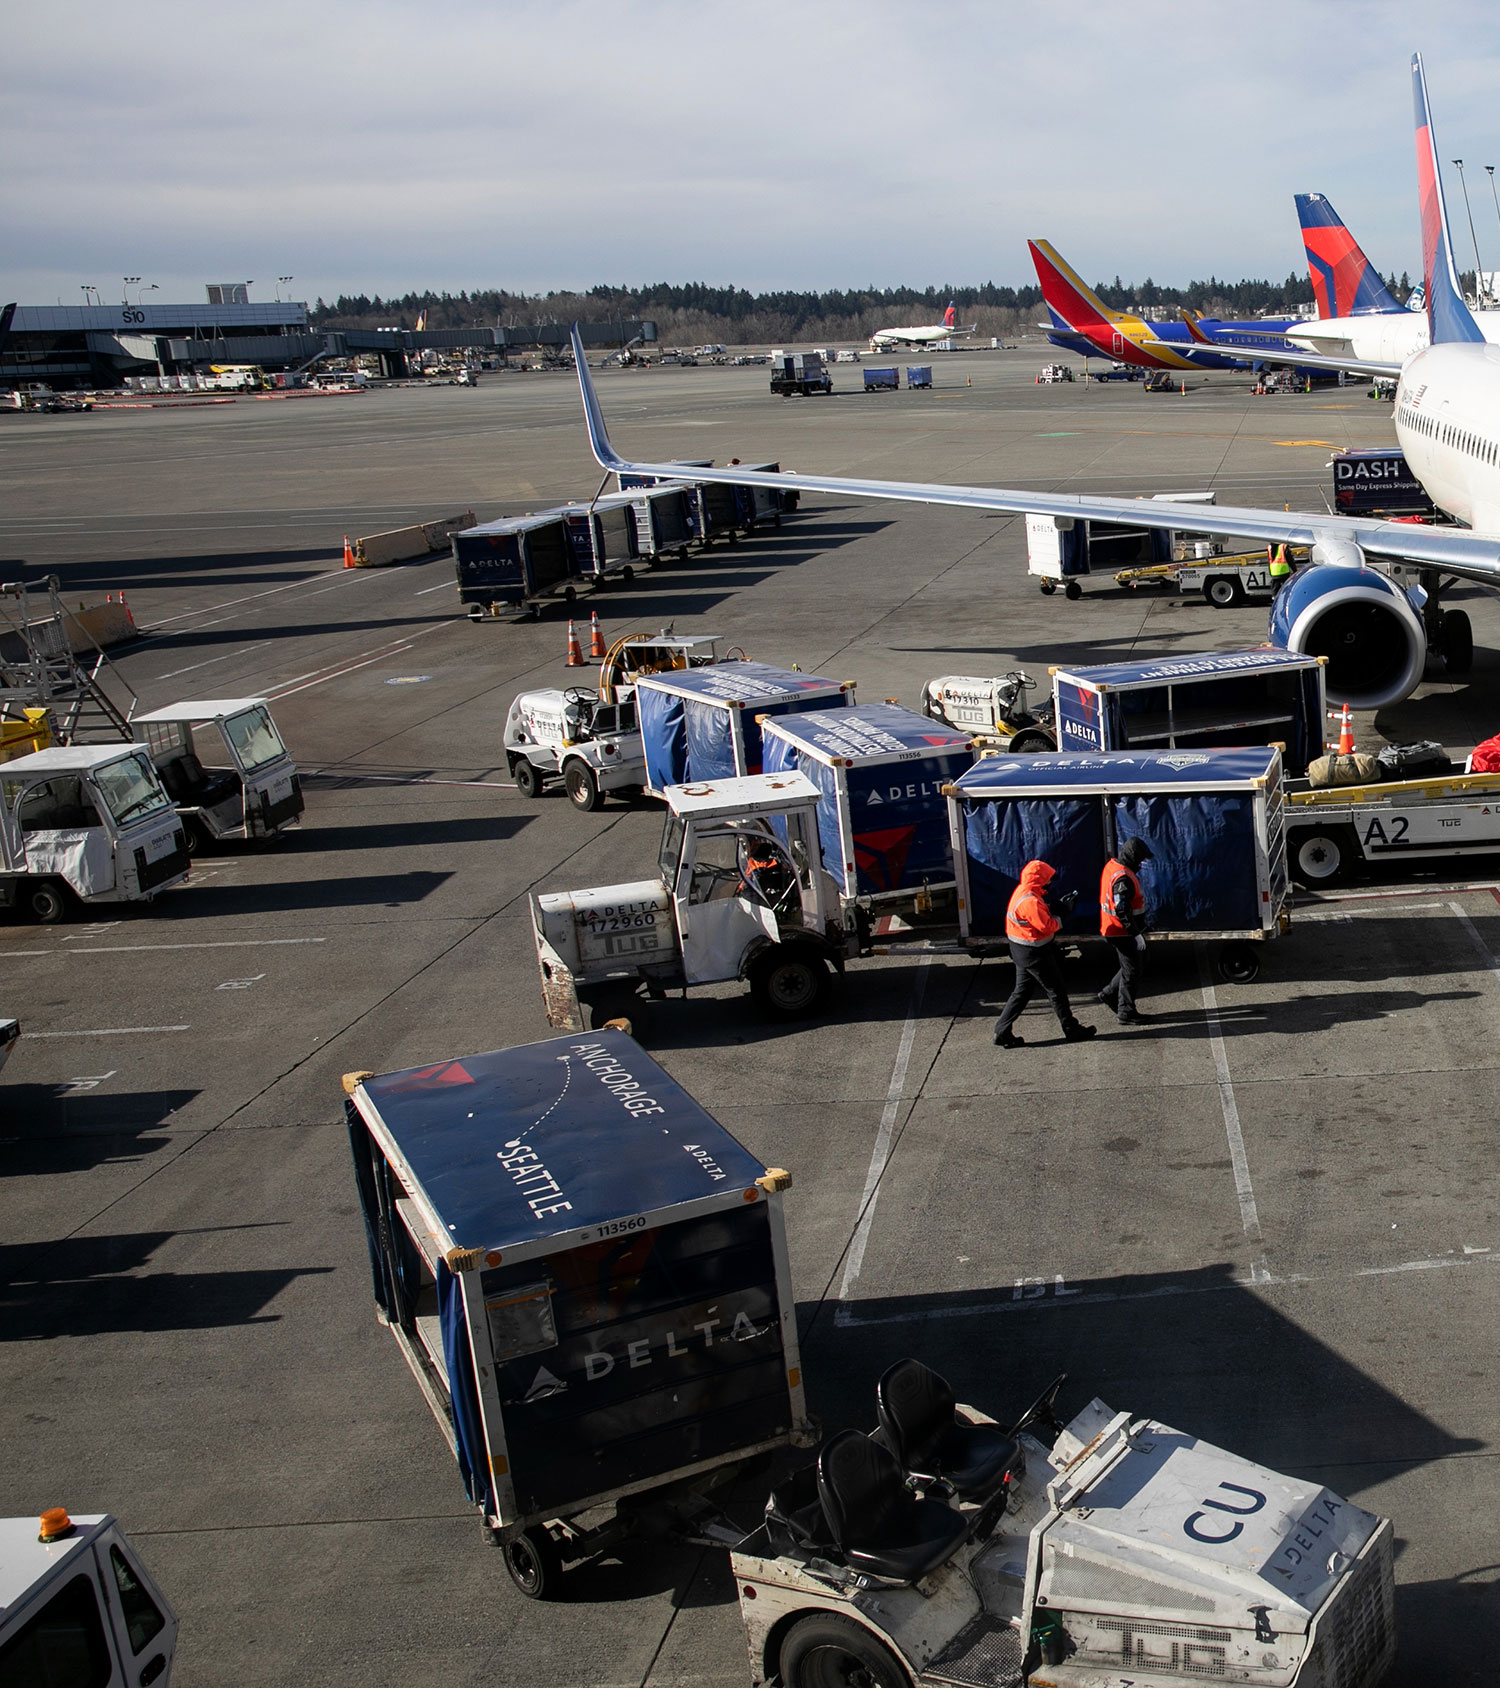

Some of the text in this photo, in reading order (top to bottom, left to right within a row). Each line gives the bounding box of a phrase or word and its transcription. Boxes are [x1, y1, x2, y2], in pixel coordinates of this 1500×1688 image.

[122, 311, 145, 324] S10
[1337, 461, 1399, 480] DASH
[1338, 481, 1420, 491] Same Day Express Shipping
[479, 558, 514, 568] DELTA
[1246, 571, 1267, 586] A1
[952, 705, 984, 722] TUG
[537, 720, 561, 731] DELTA
[1072, 723, 1097, 743] DELTA
[898, 751, 921, 760] 113556
[1032, 757, 1135, 768] DELTA
[1363, 816, 1410, 846] A2
[605, 900, 660, 917] DELTA
[589, 913, 655, 932] 172960
[593, 926, 659, 955] TUG
[568, 1042, 666, 1119] ANCHORAGE
[691, 1150, 727, 1182] DELTA
[496, 1144, 573, 1220] SEATTLE
[597, 1216, 647, 1238] 113560
[1012, 1274, 1083, 1301] BL
[584, 1310, 761, 1381] DELTA
[1182, 1481, 1268, 1545] CU
[1288, 1497, 1342, 1565] DELTA
[1096, 1617, 1232, 1676] TUG
